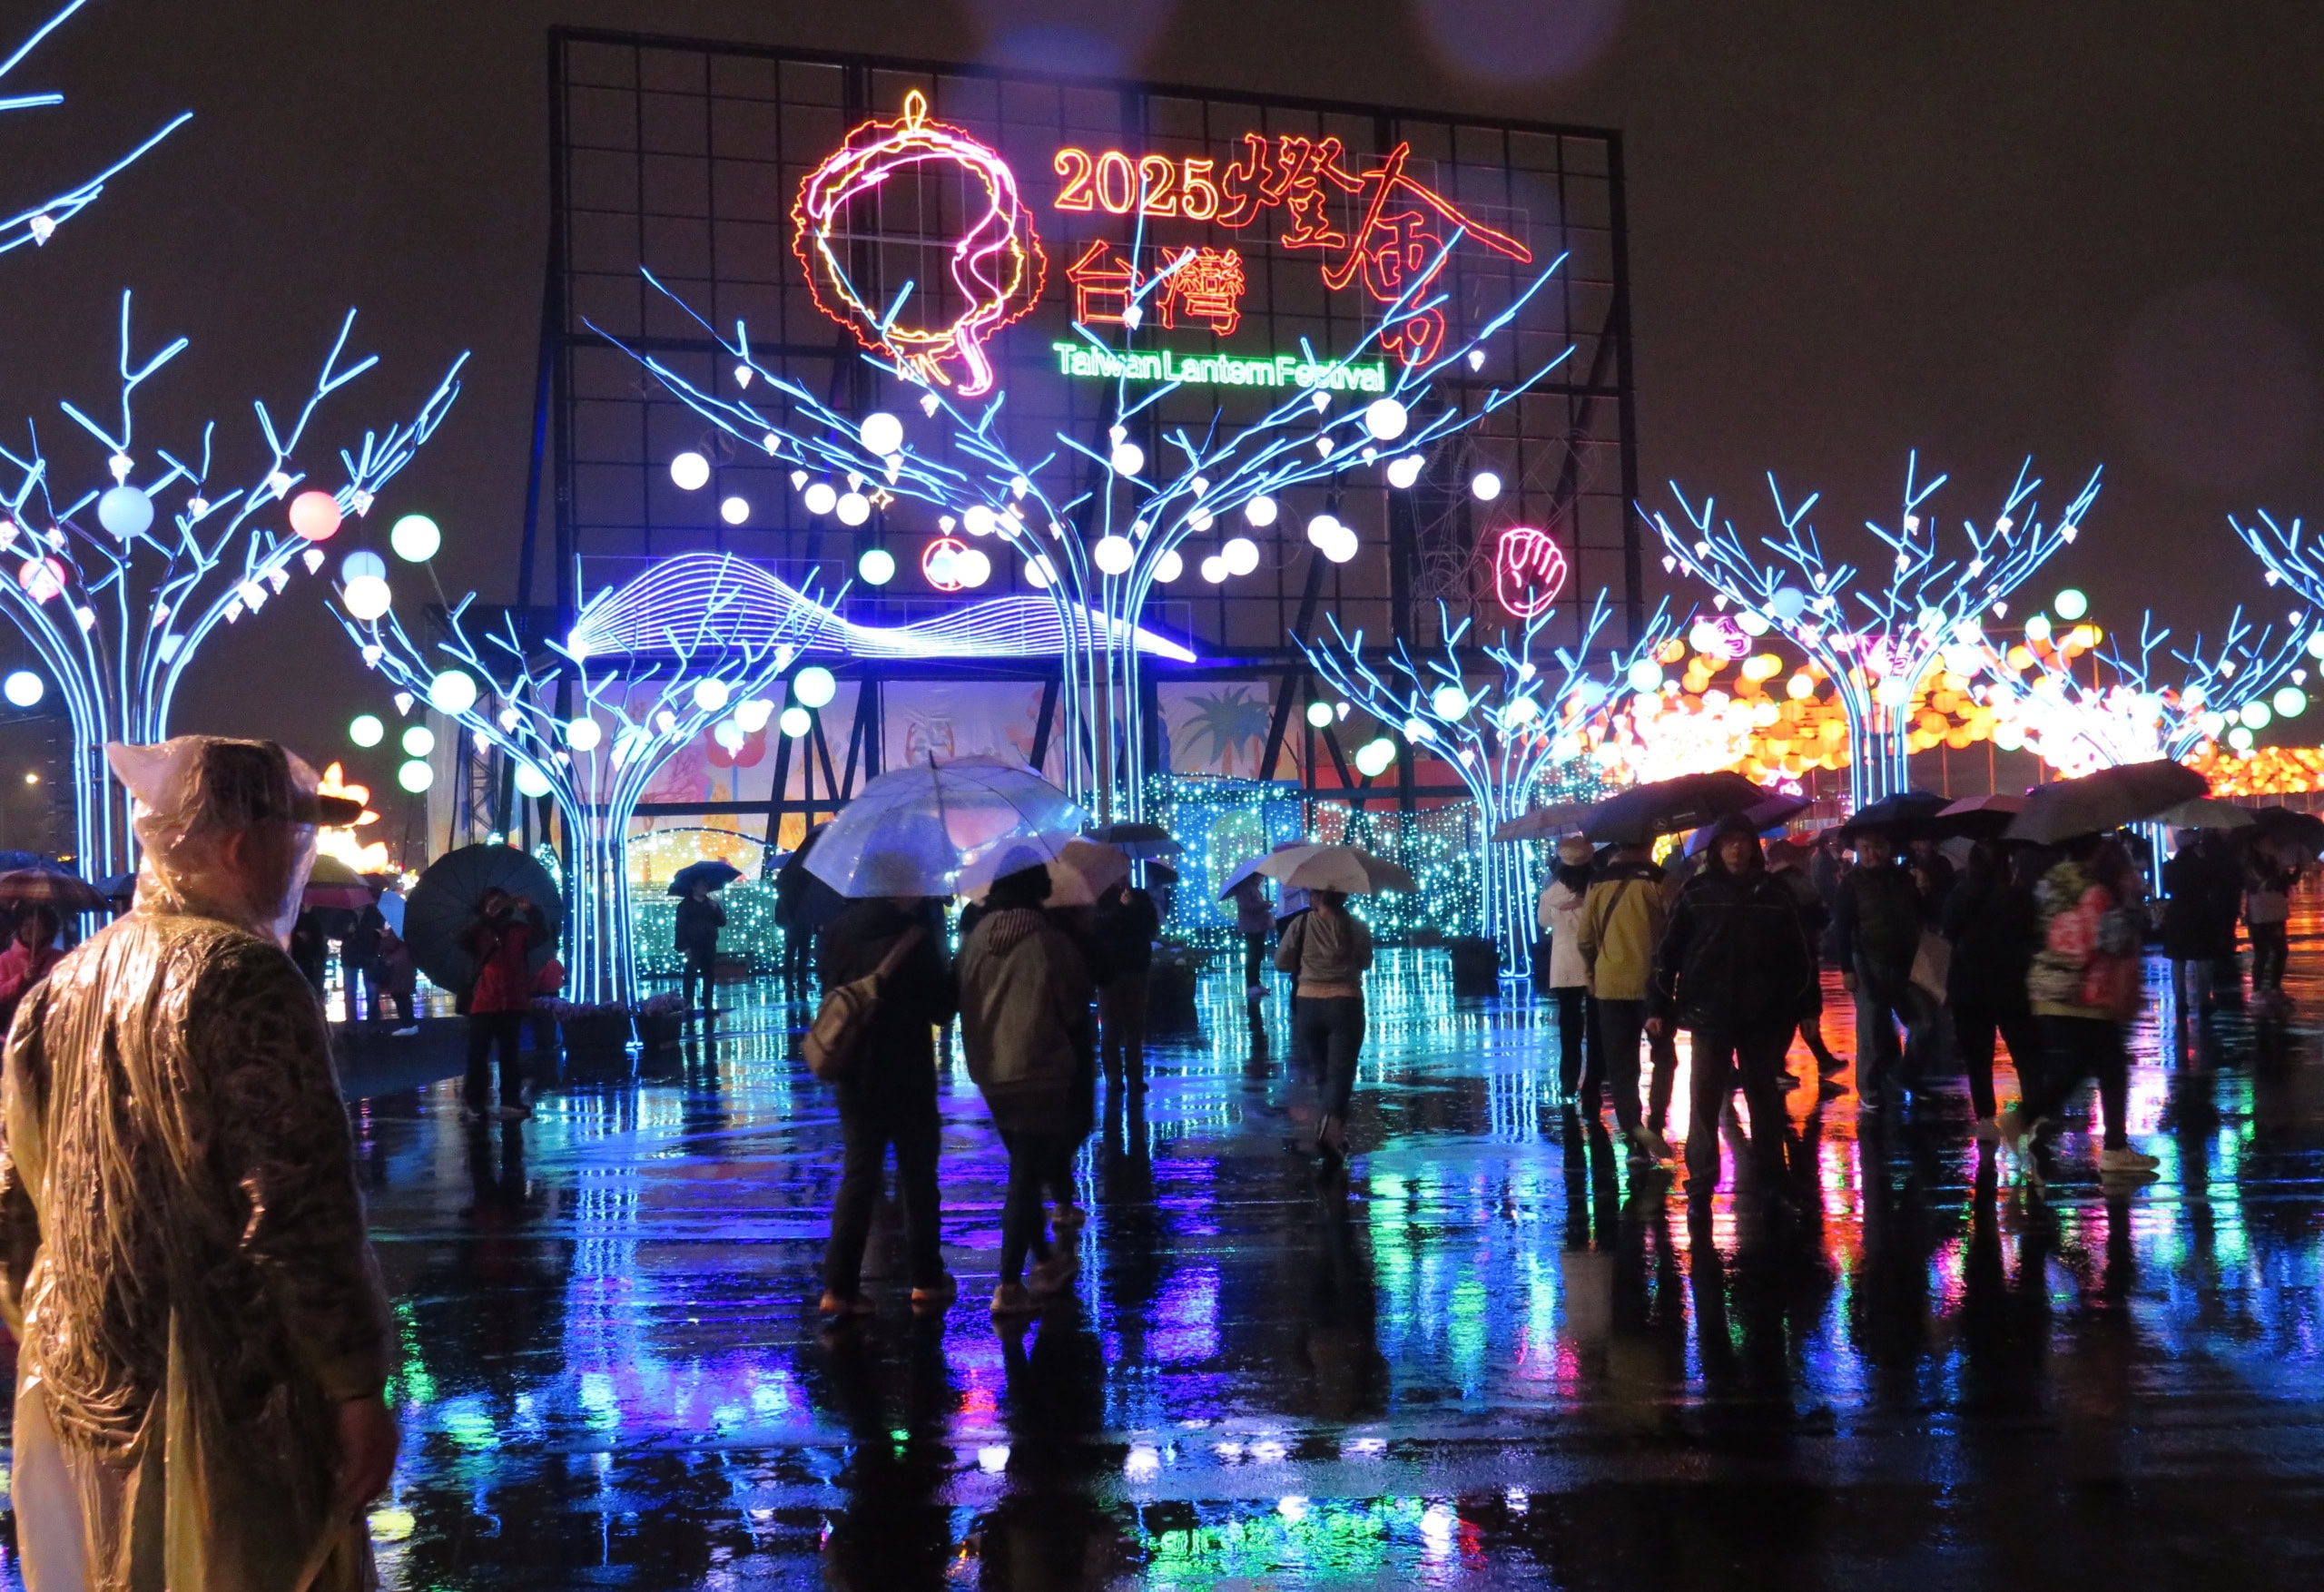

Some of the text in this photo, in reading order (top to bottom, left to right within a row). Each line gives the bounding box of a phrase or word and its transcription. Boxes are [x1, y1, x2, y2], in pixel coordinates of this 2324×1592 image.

[1054, 148, 1218, 220] 2025
[1066, 240, 1245, 337] 台灣
[1053, 343, 1386, 392] Taiwan Lantern Festival
